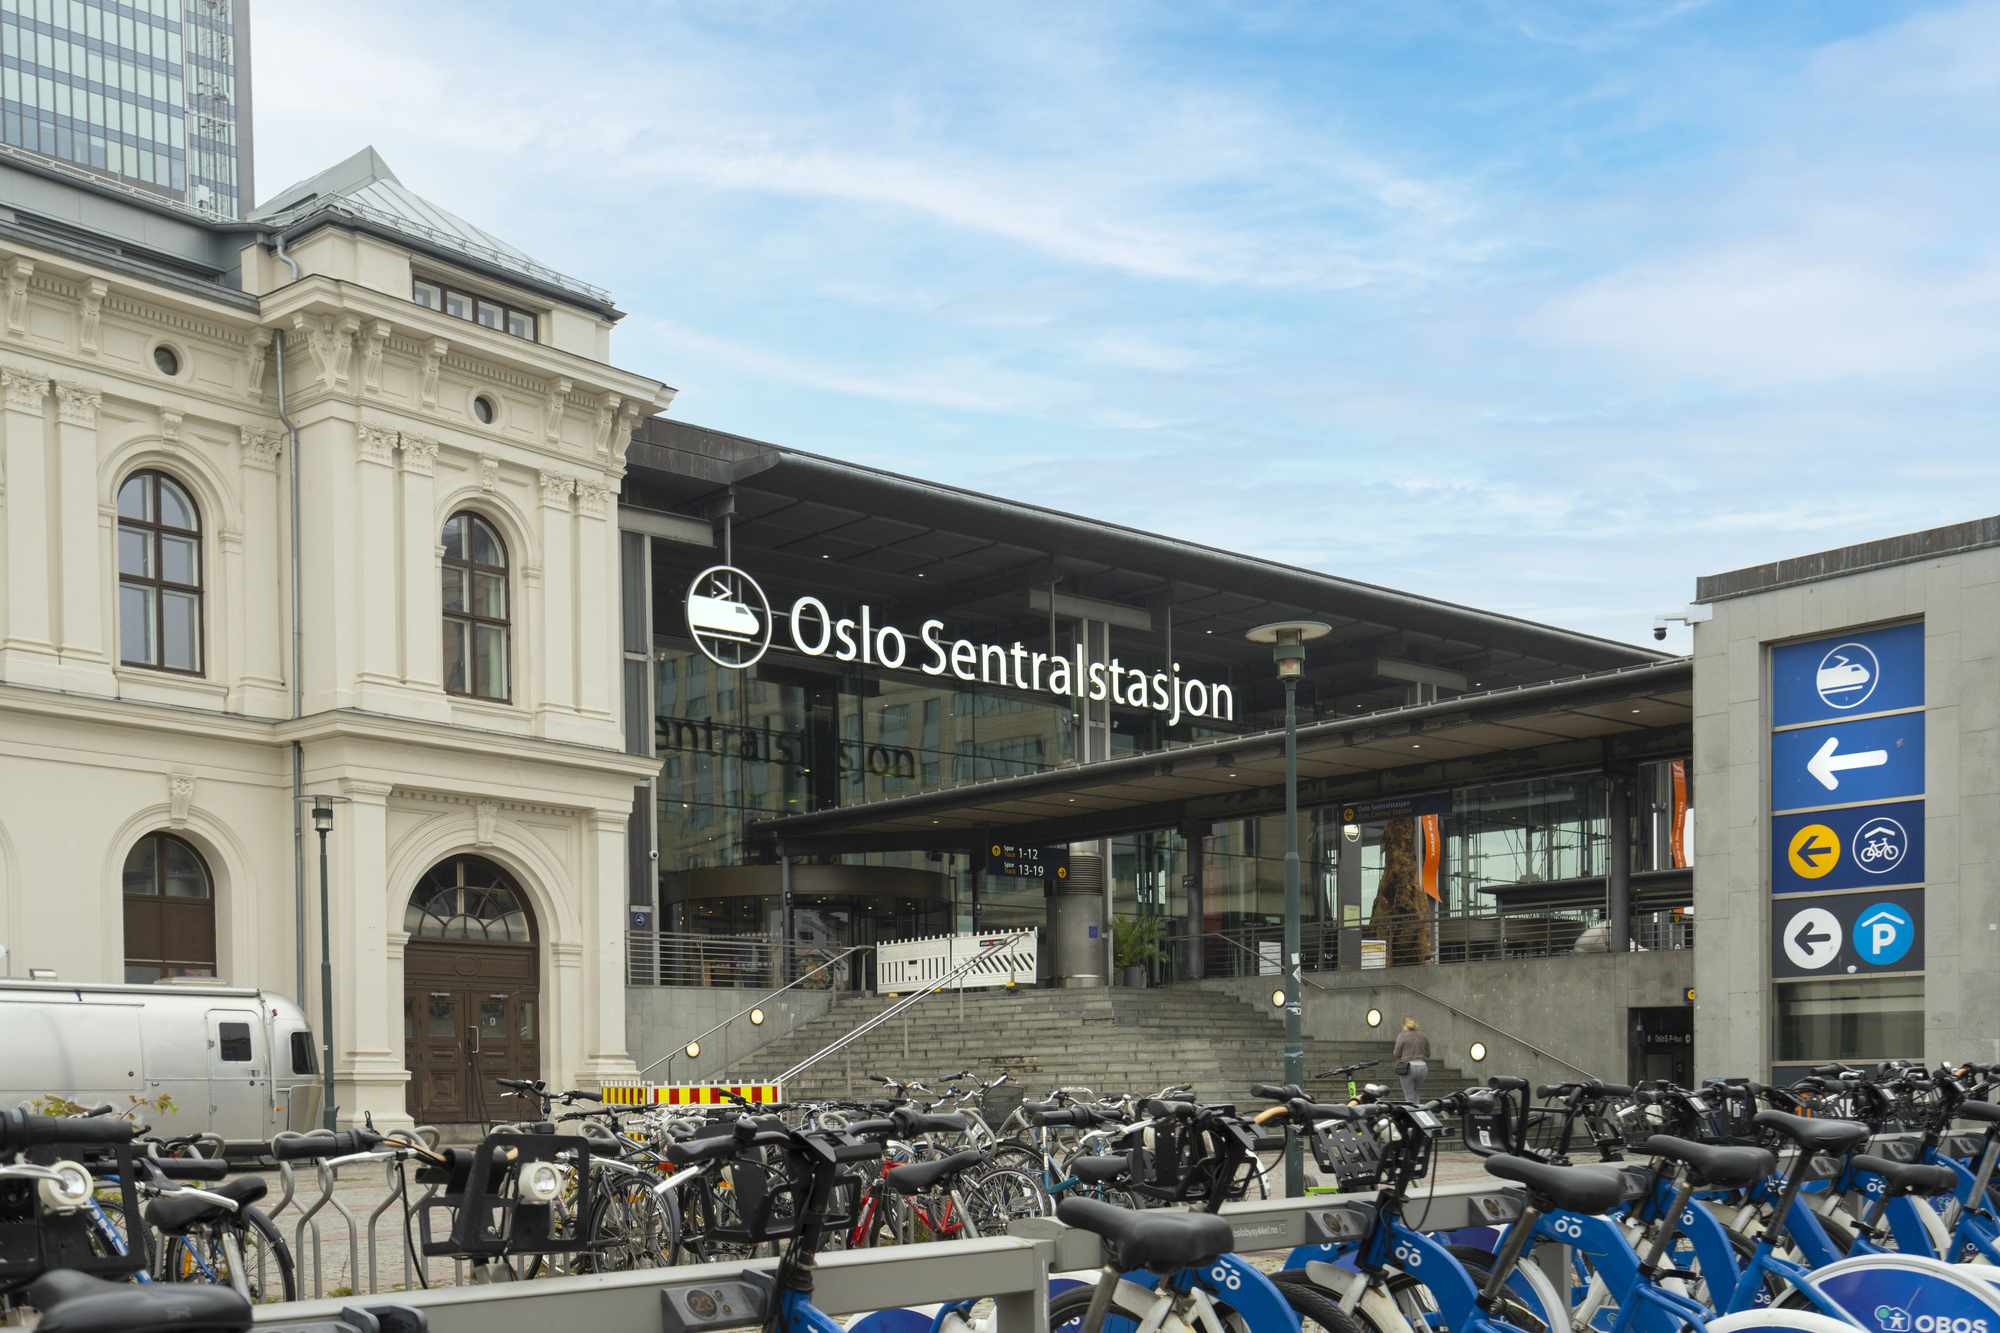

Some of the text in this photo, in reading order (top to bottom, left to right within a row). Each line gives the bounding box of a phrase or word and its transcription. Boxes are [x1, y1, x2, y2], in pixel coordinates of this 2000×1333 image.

[789, 596, 1234, 727] Oslo Sentralstasjon
[1357, 800, 1411, 813] Oslo Sentralstasjon
[1357, 807, 1413, 820] Oslo Central Station
[1003, 844, 1038, 860] Spor 1-12
[1019, 864, 1044, 877] 13-19
[1872, 923, 1896, 955] P
[1232, 1225, 1278, 1238] oslobysykkel.no
[690, 1295, 715, 1312] 23
[1915, 1315, 1988, 1333] OBOS
